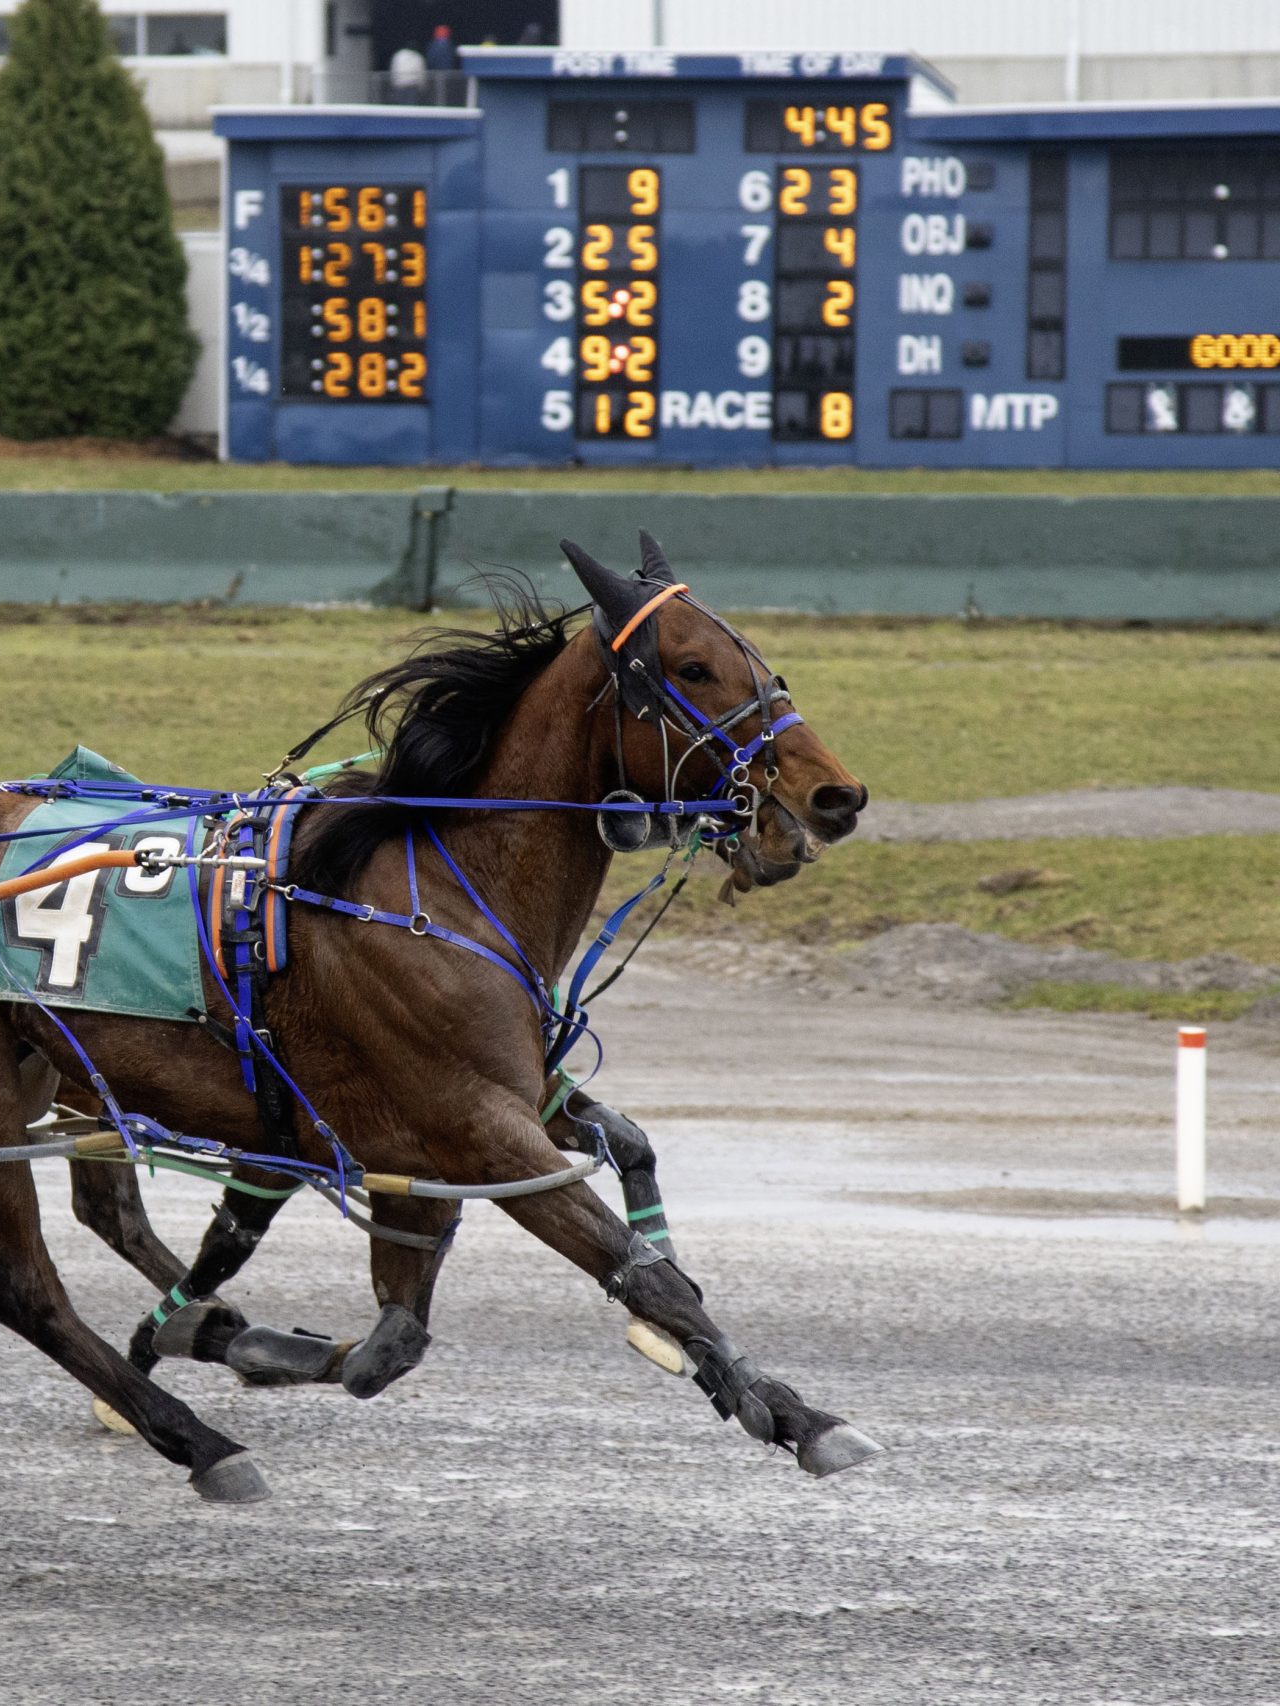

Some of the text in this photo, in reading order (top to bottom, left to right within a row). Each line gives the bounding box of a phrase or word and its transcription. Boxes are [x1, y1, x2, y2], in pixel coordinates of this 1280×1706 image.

[623, 54, 677, 77] TIME
[741, 54, 886, 77] TIME OF DAY
[546, 168, 569, 209] 1
[627, 168, 660, 216] 9
[739, 170, 772, 212] 6
[901, 156, 966, 198] PHO
[234, 189, 263, 229] F
[299, 187, 426, 233] 1:56:1
[543, 227, 574, 269] 2
[741, 224, 771, 266] 7
[823, 227, 856, 268] 4
[901, 213, 966, 256] OBJ
[299, 242, 426, 288] 1:27:3
[543, 279, 575, 322] 3
[737, 279, 770, 322] 8
[823, 280, 855, 327] 2
[899, 272, 955, 315] INQ
[540, 335, 575, 377] 4
[737, 335, 770, 378] 9
[897, 334, 942, 375] DH
[1188, 334, 1280, 369] GOOD
[540, 389, 574, 432] 5
[660, 390, 772, 429] RACE
[821, 391, 854, 439] 8
[971, 393, 1059, 432] MTP
[14, 840, 111, 988] 4
